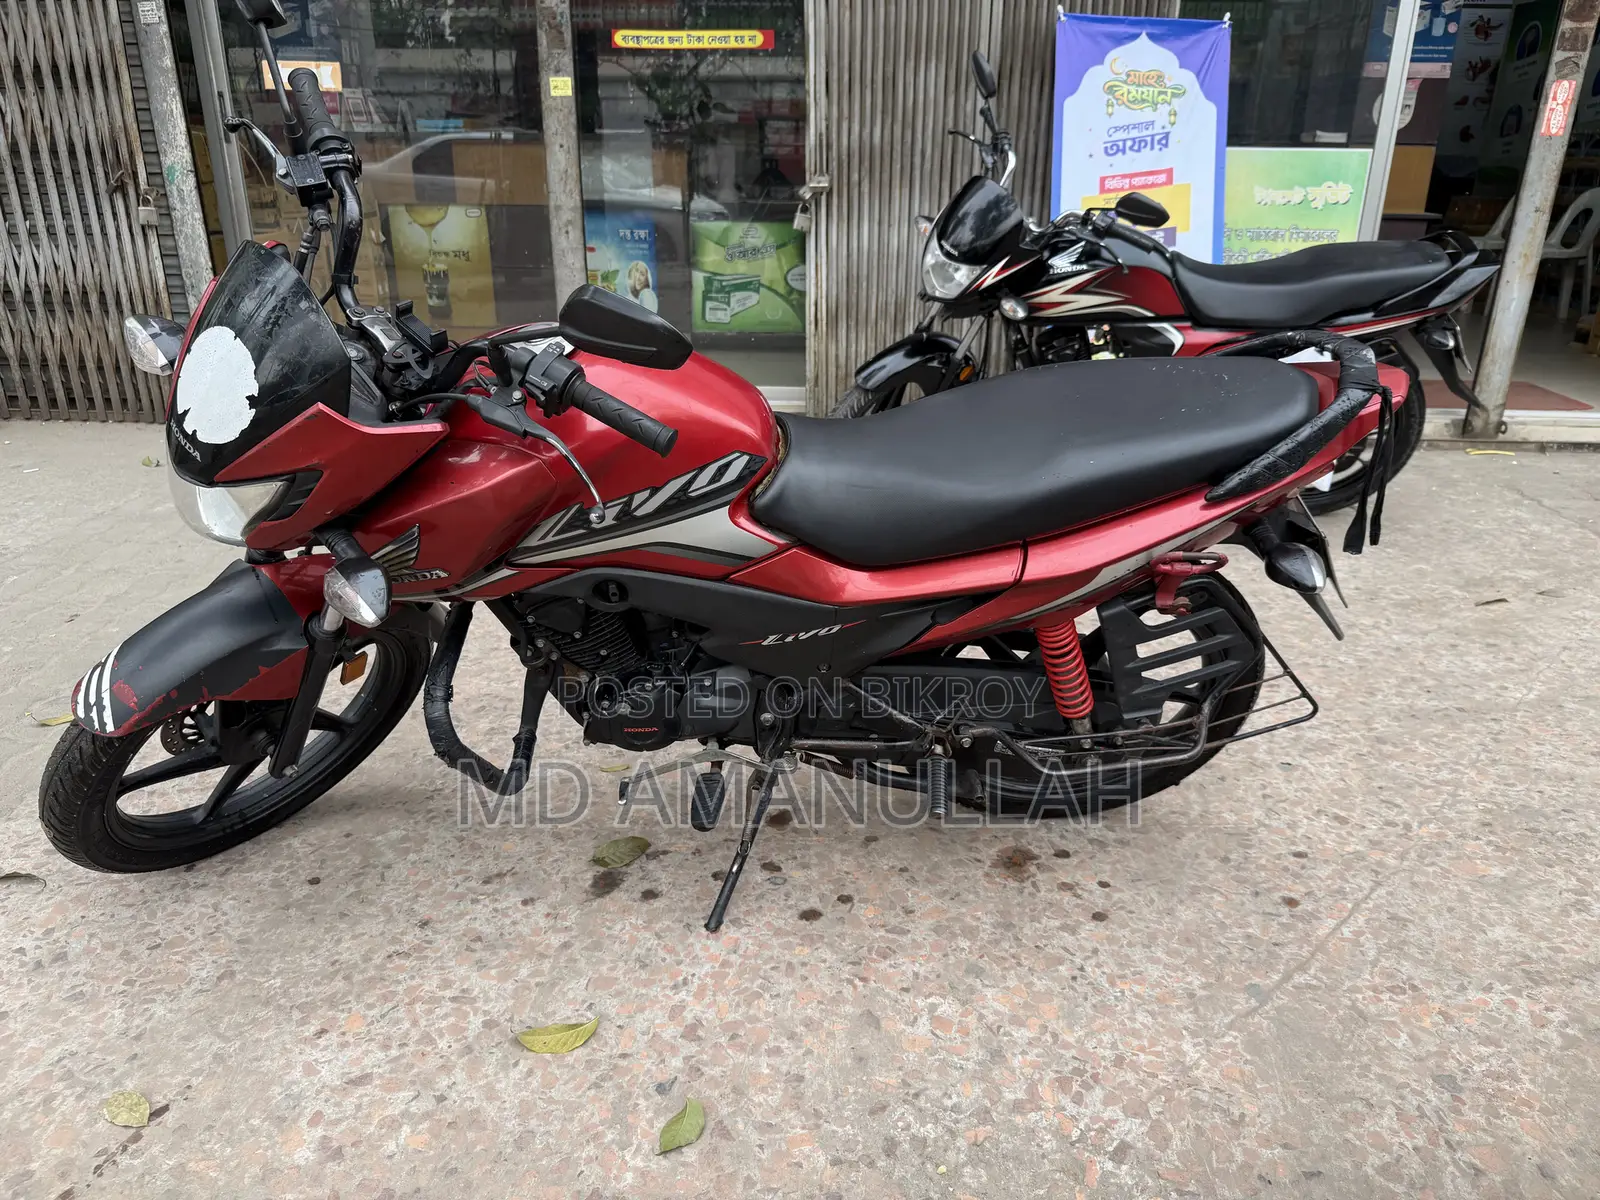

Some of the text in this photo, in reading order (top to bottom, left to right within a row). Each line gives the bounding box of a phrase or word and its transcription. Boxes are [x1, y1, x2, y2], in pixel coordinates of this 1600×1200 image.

[620, 33, 757, 47] ব্যবস্থাপত্রের জন্য টাকা নেওয়া হয় না
[1107, 120, 1156, 138] স্পেশাল
[1103, 131, 1171, 157] অফার
[632, 229, 650, 241] রক্ষা
[1049, 264, 1088, 274] HONDA
[171, 418, 202, 462] HONDA
